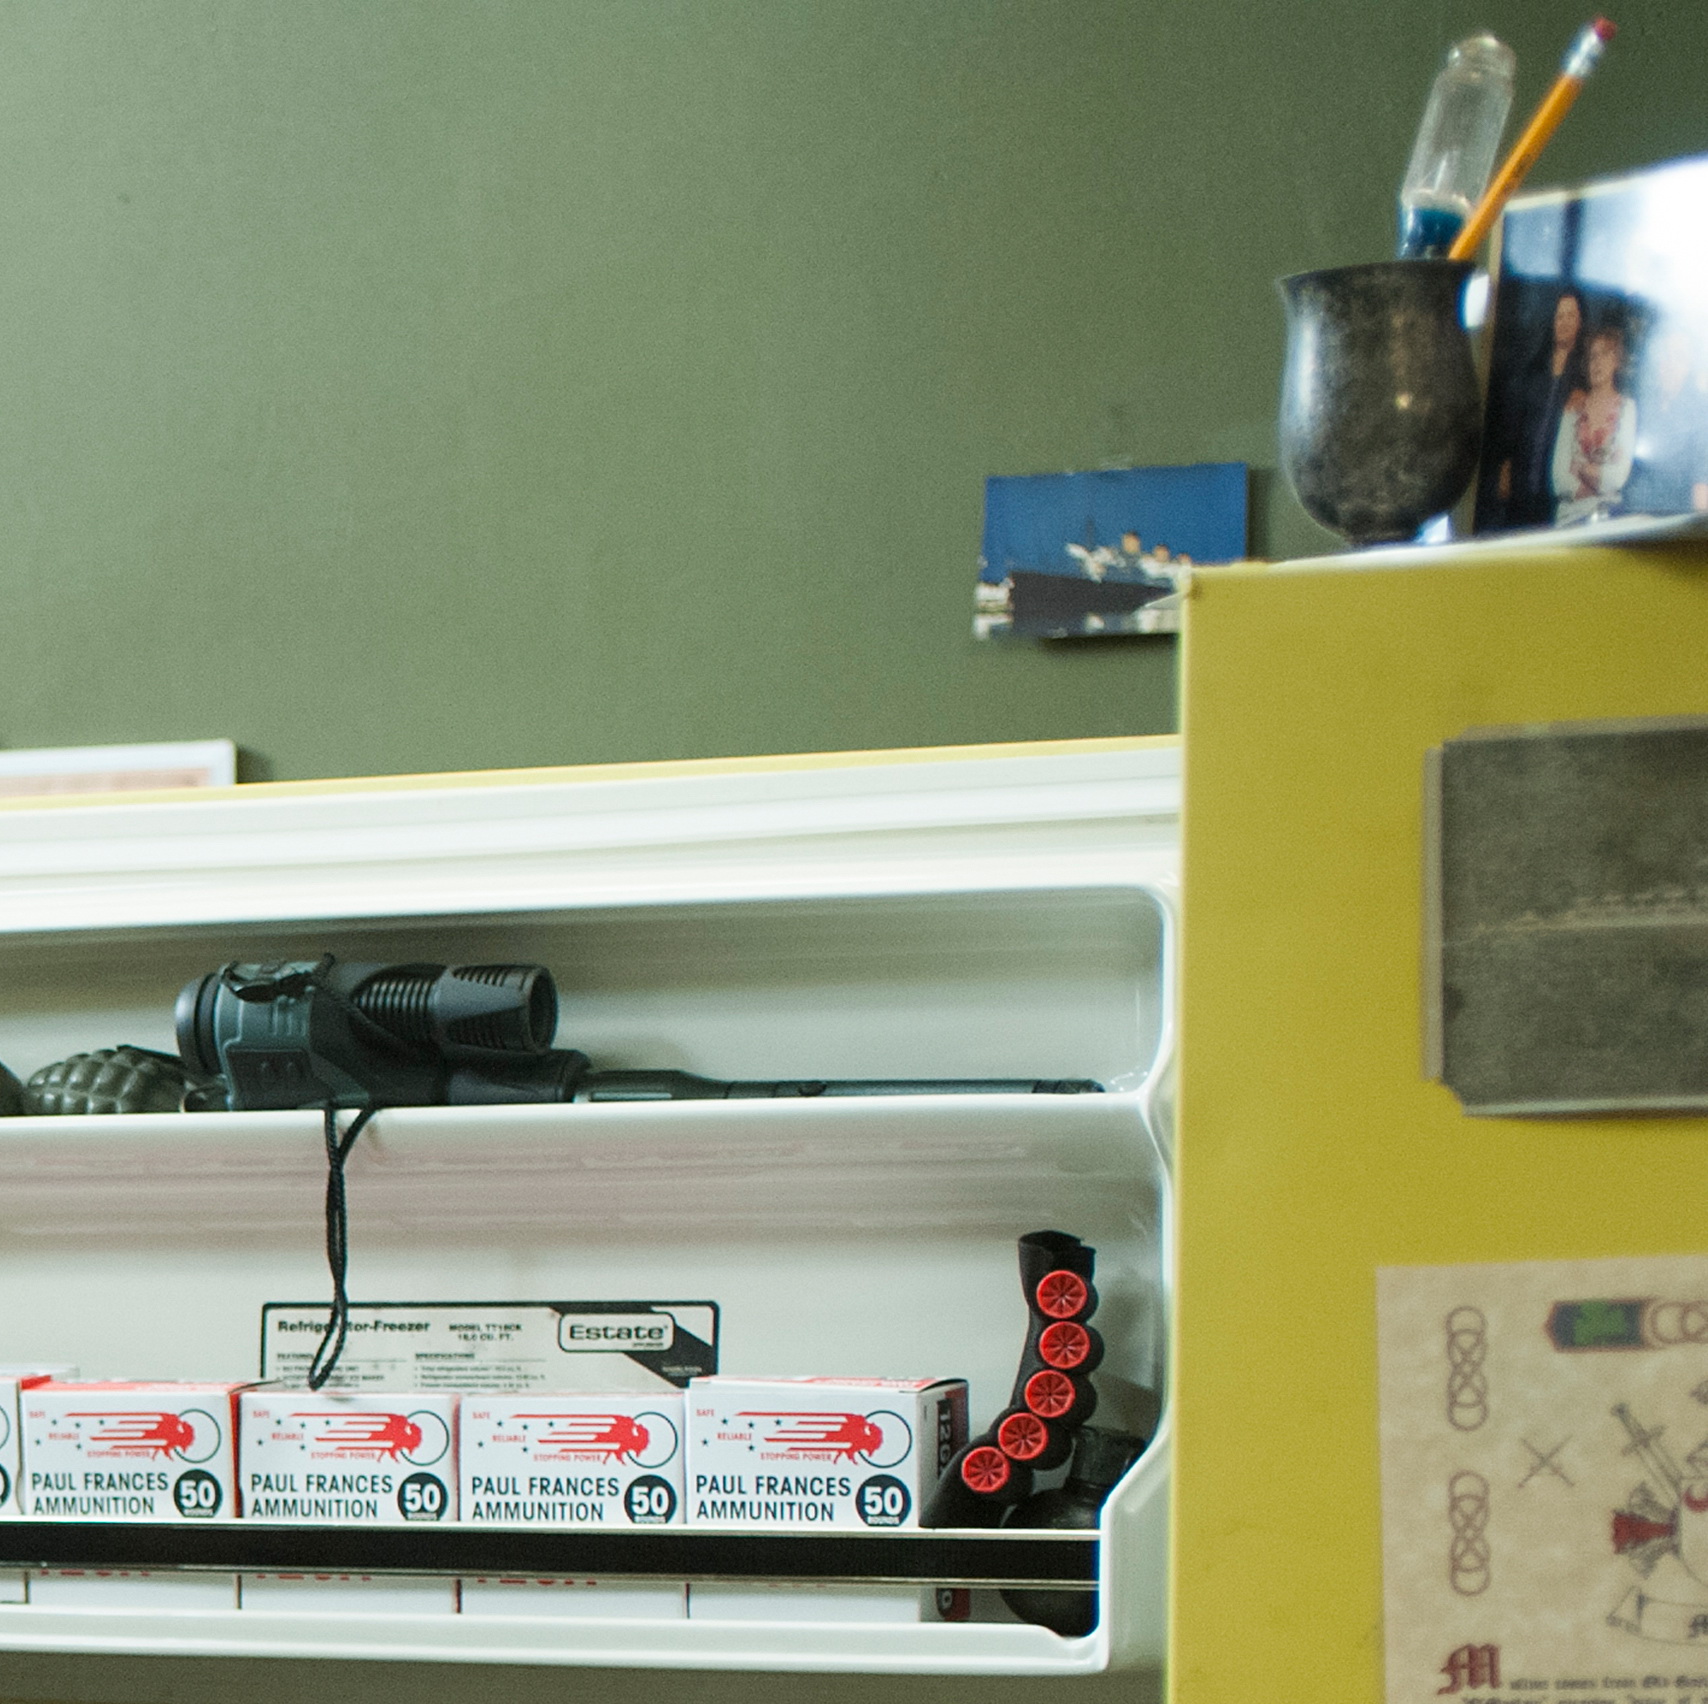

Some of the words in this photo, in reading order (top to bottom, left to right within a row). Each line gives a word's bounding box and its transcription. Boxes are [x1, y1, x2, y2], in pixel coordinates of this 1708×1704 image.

[569, 1324, 665, 1340] Estate
[717, 1432, 752, 1441] RELIABLE
[32, 1472, 76, 1490] PAUL
[84, 1472, 169, 1491] FRANCES
[251, 1473, 298, 1492] PAUL
[306, 1474, 393, 1493] FRANCES
[472, 1476, 520, 1495] PAUL
[529, 1477, 620, 1496] FRANCES
[696, 1475, 746, 1494] PAUL
[756, 1476, 851, 1496] FRANCES
[179, 1479, 216, 1508] 50
[404, 1482, 442, 1512] 50
[631, 1486, 670, 1515] 50
[864, 1486, 903, 1515] 50
[33, 1496, 155, 1515] AMMUNITION
[252, 1499, 378, 1518] AMMUNITION
[472, 1502, 604, 1521] AMMUNITION
[697, 1500, 834, 1521] AMMUNITION
